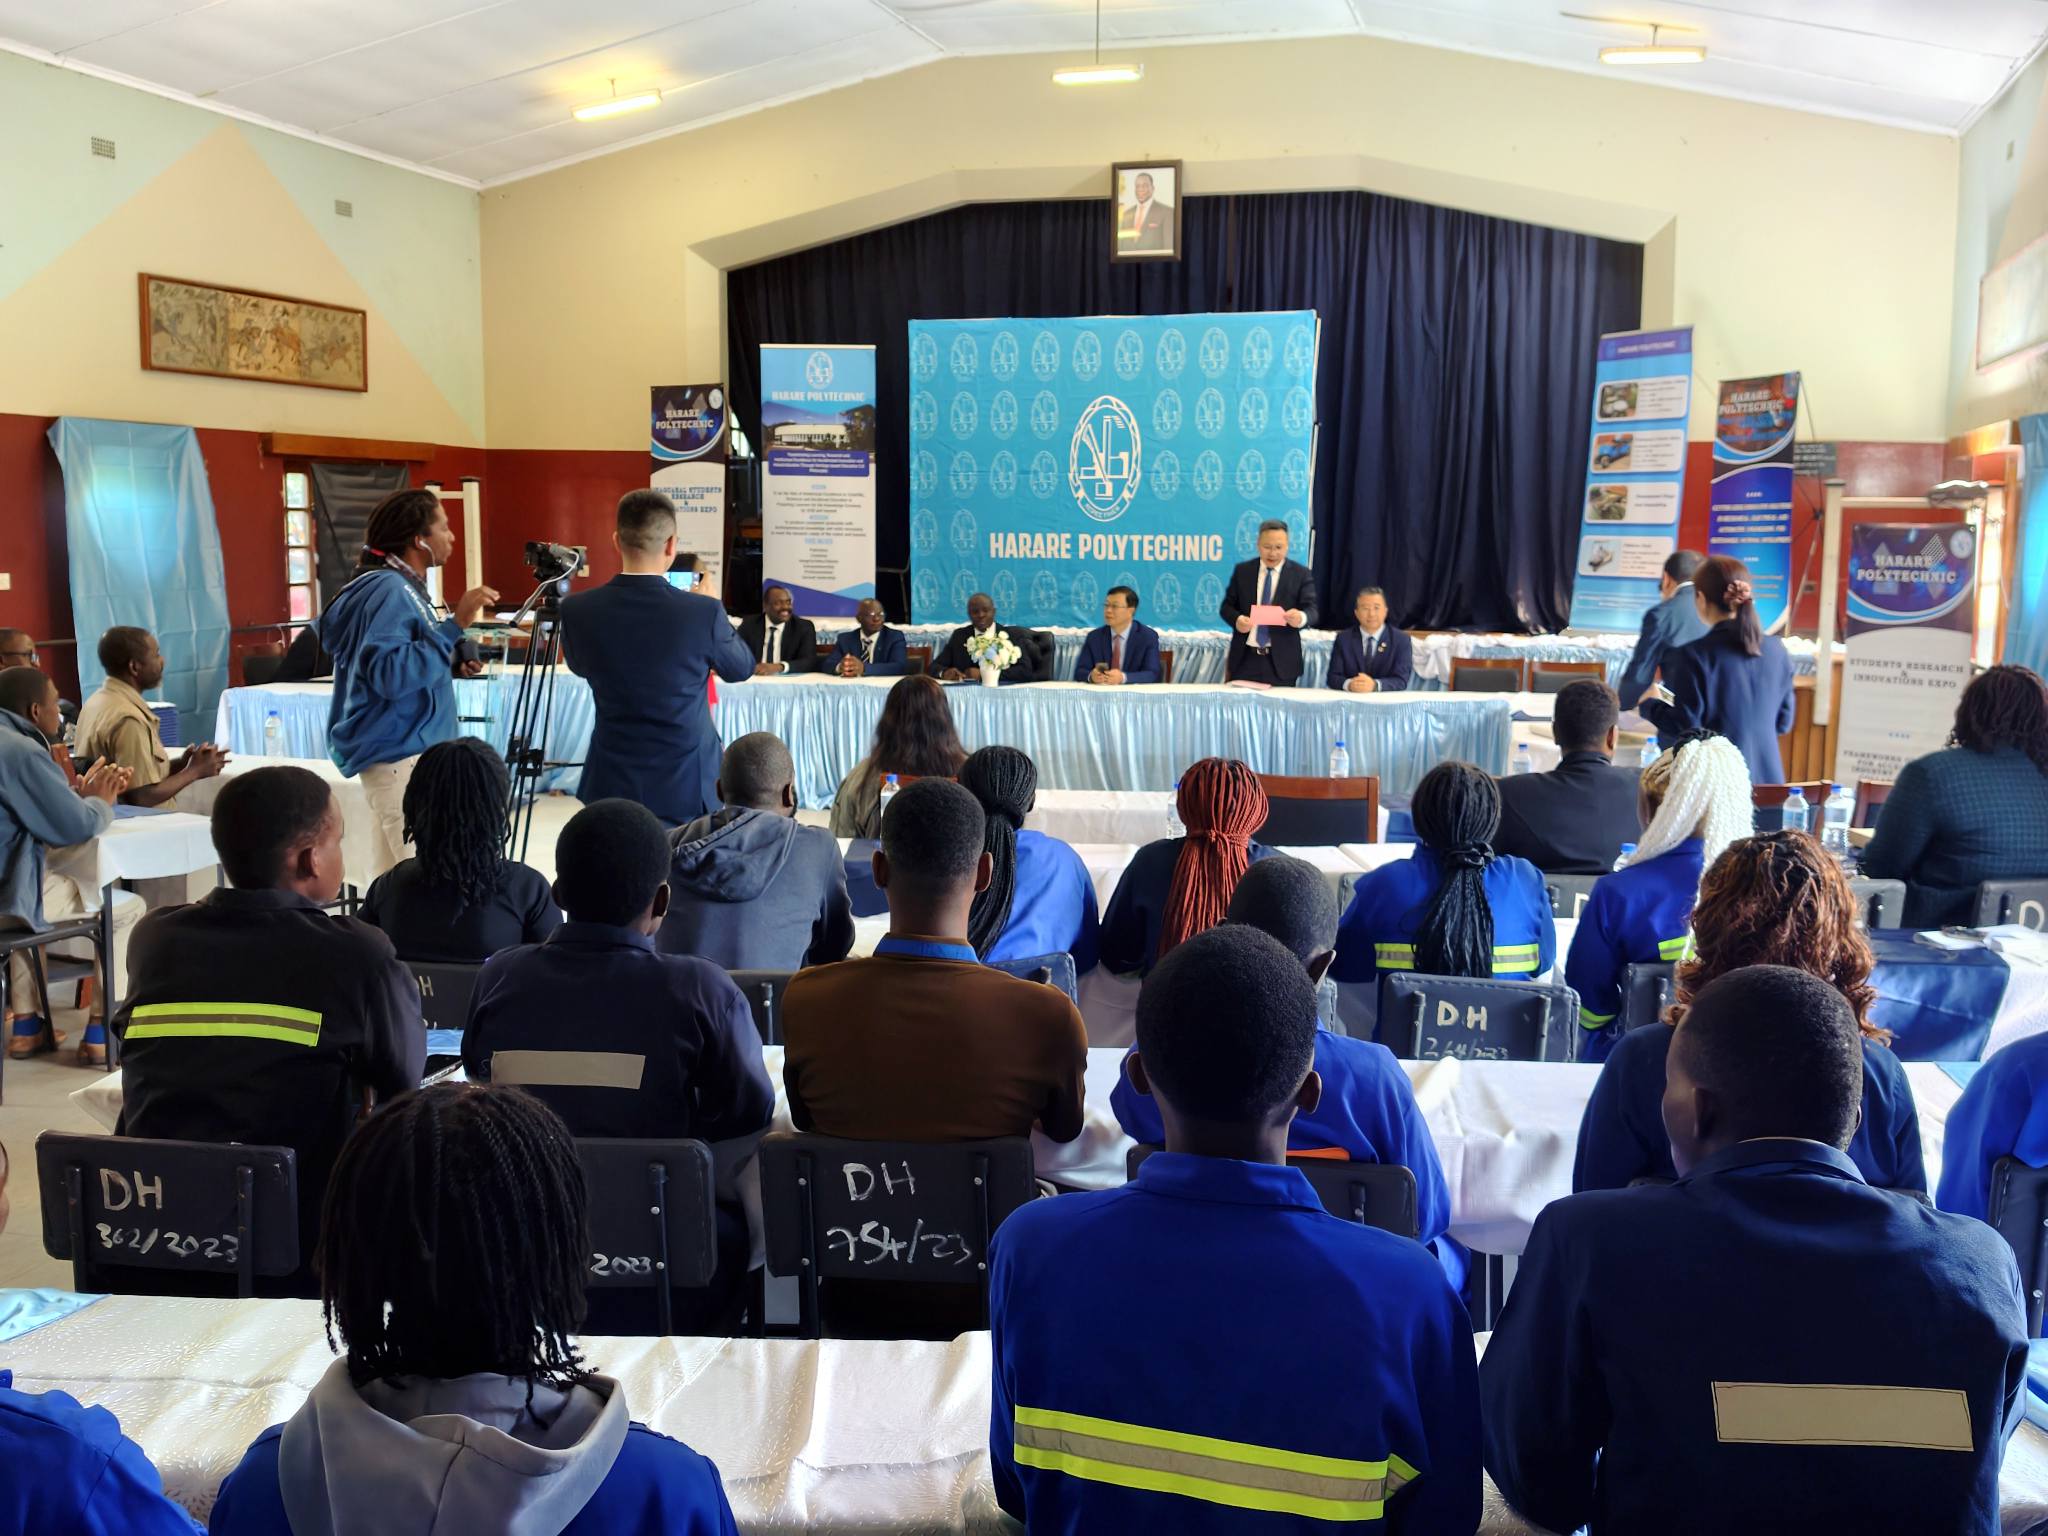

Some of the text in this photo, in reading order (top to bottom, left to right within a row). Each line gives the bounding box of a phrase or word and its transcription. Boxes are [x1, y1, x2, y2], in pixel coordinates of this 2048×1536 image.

[665, 408, 700, 418] HARARE
[655, 419, 715, 430] POLYTECHNIC
[989, 533, 1223, 561] HARARE POLYTECHNIC
[1875, 554, 1933, 568] HARARE
[1857, 568, 1957, 584] POLYTECHNIC
[1850, 658, 1964, 673] STUDENTS RESEARCH
[1854, 673, 1957, 688] INNOVATIONS EXPO
[418, 975, 434, 997] H
[1436, 1000, 1487, 1031] DH
[845, 1161, 916, 1201] DH
[100, 1168, 162, 1211] DH
